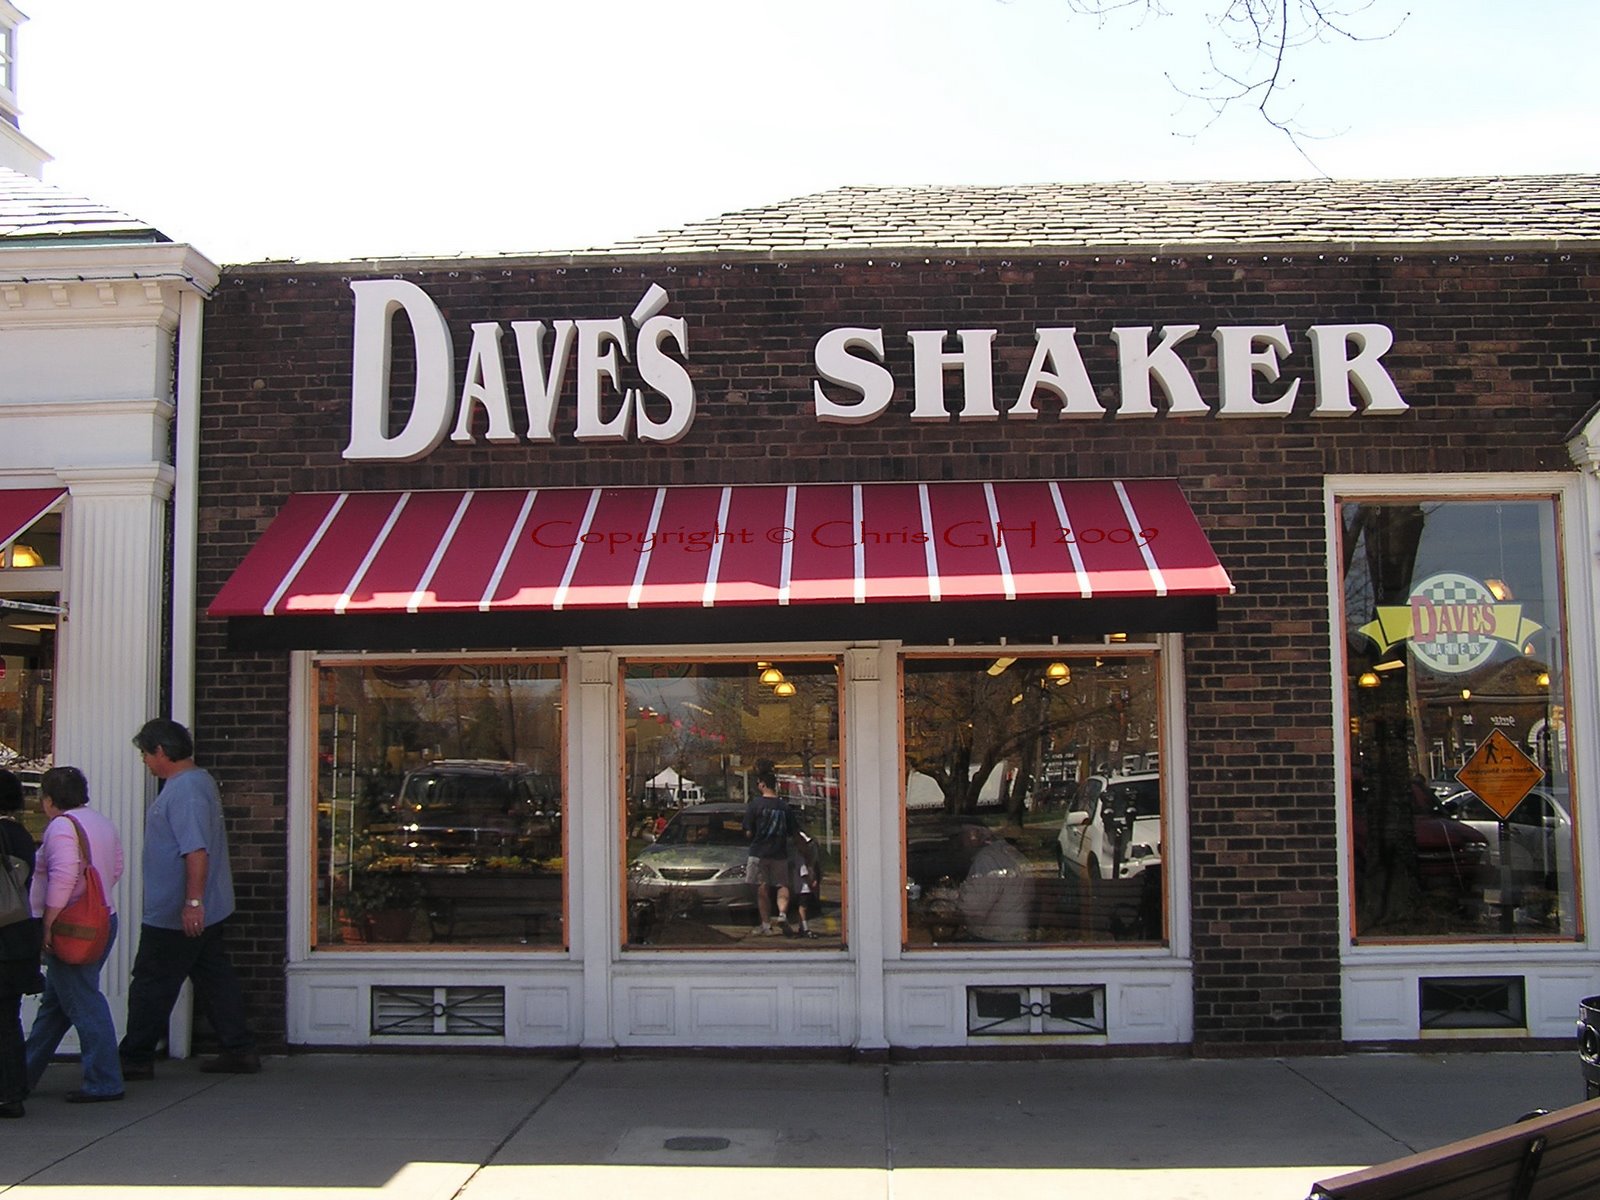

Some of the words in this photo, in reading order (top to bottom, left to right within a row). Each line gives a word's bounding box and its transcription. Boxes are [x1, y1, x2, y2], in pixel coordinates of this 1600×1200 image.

[342, 279, 696, 462] DAVE'S
[813, 323, 1411, 424] SHAKER
[1410, 594, 1497, 642] DAVE'S
